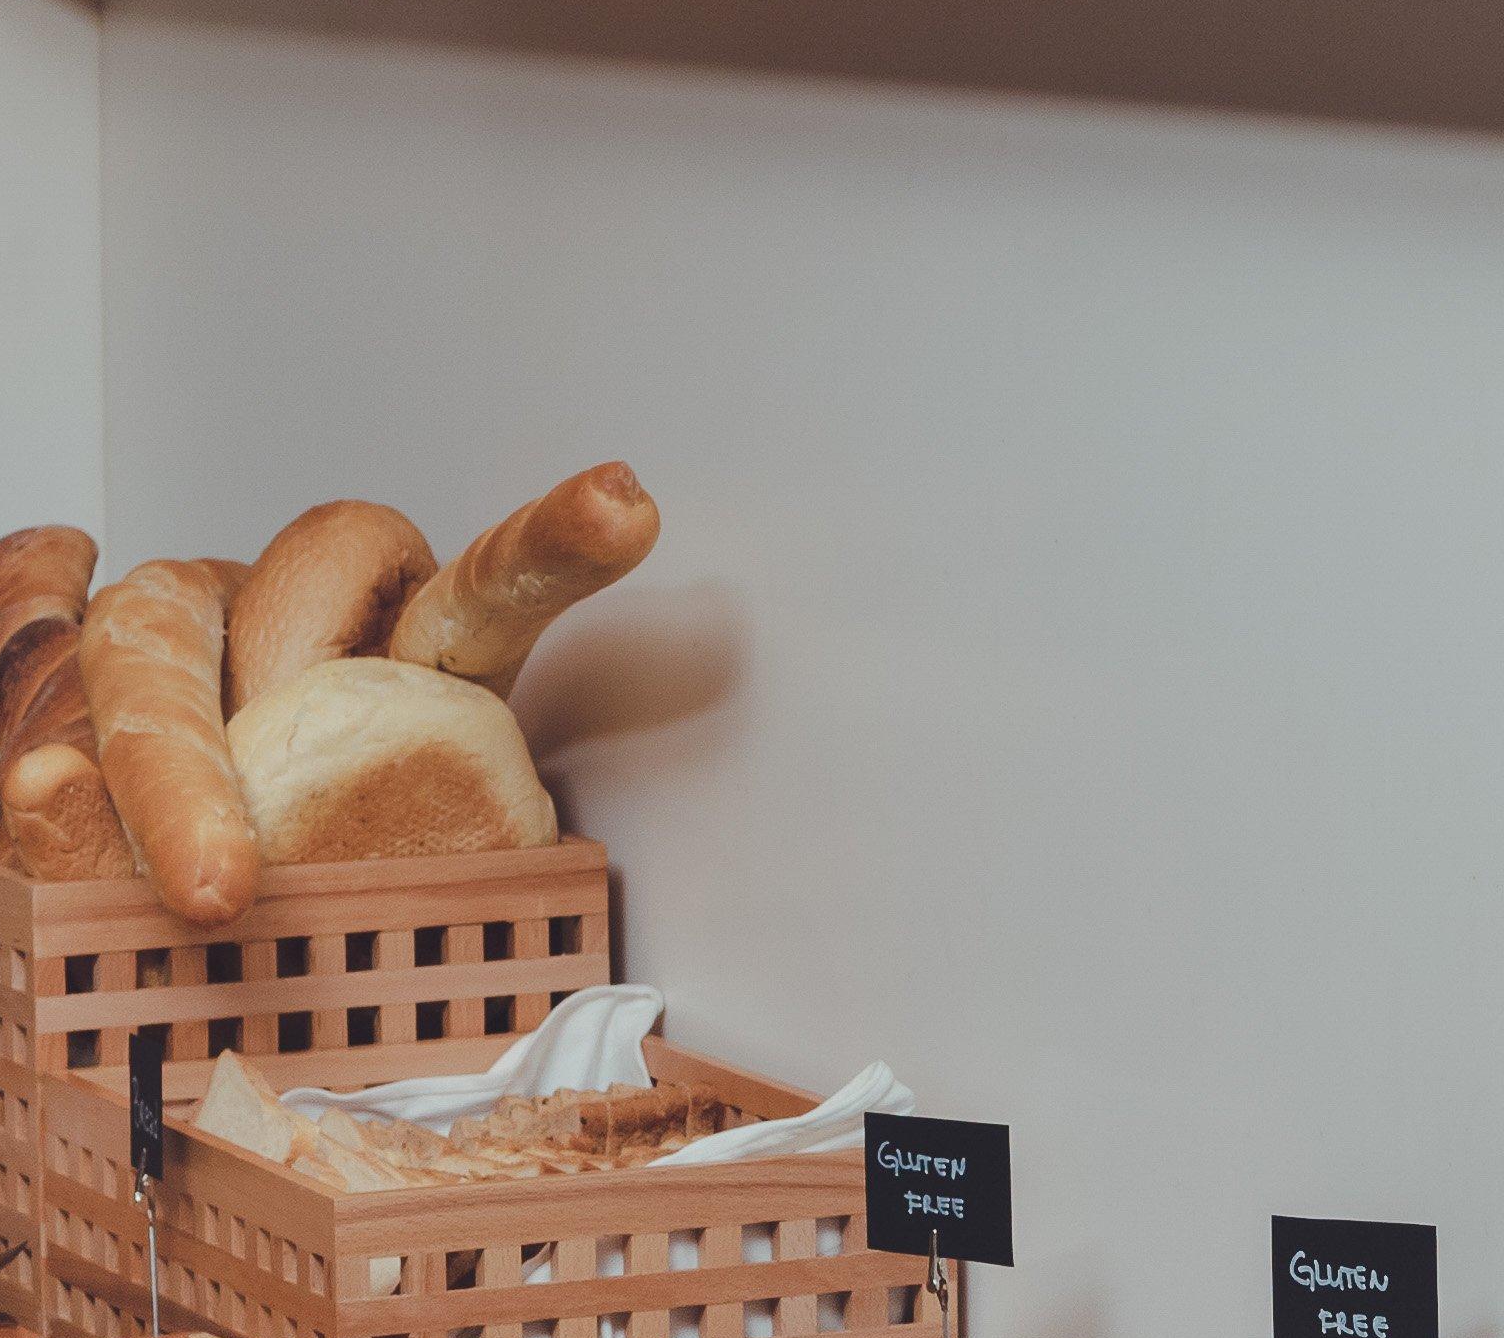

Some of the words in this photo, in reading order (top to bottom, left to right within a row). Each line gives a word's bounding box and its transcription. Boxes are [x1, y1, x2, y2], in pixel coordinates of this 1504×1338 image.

[877, 1140, 967, 1181] GLUTEN
[903, 1189, 965, 1219] FREE
[1289, 1250, 1390, 1293] GLUTEN
[1317, 1308, 1390, 1338] FREE
